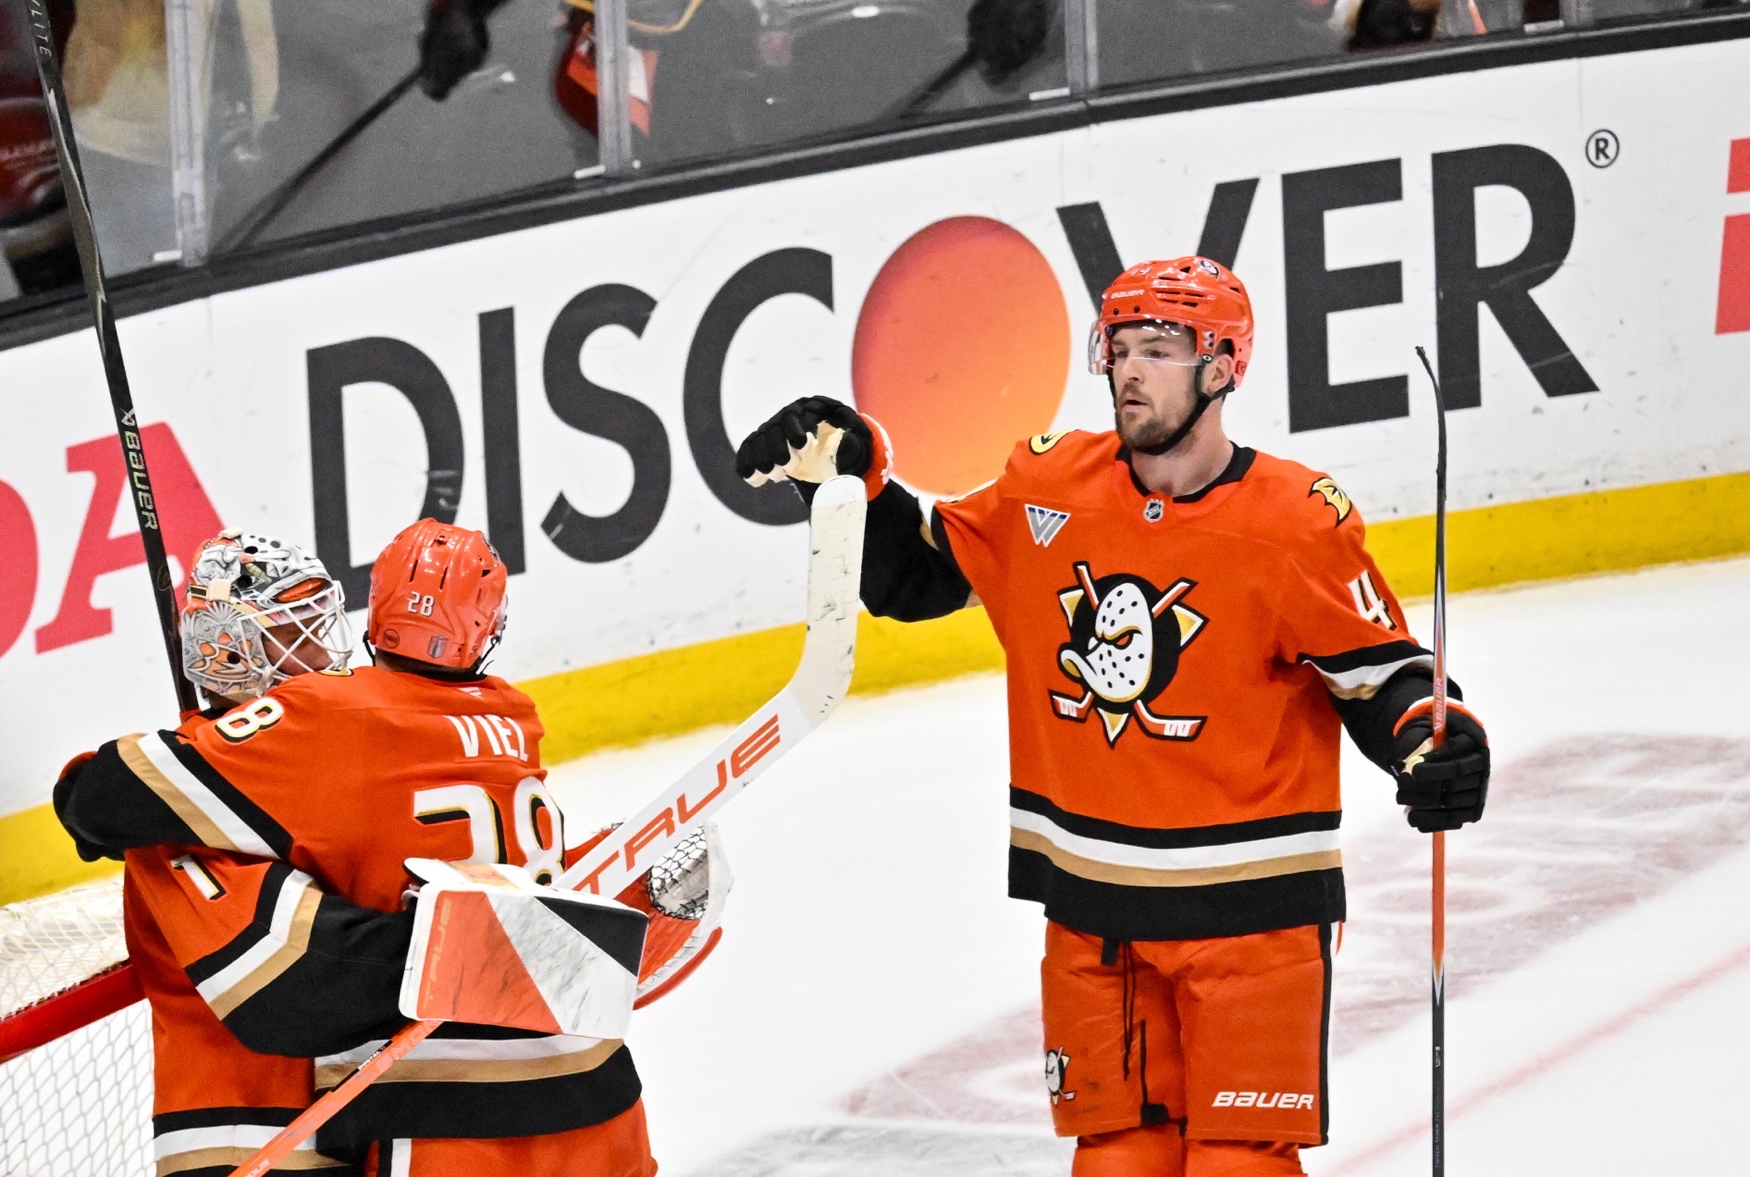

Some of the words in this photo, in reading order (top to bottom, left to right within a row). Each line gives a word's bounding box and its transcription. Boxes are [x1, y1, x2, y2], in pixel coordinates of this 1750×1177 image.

[124, 430, 158, 530] BAUER
[407, 591, 434, 617] 28
[214, 698, 284, 744] 8
[444, 714, 529, 762] VIEL
[571, 713, 781, 887] TRUE
[170, 853, 227, 901] 1
[375, 1018, 444, 1073] SMOK
[1211, 1091, 1315, 1110] BAUER
